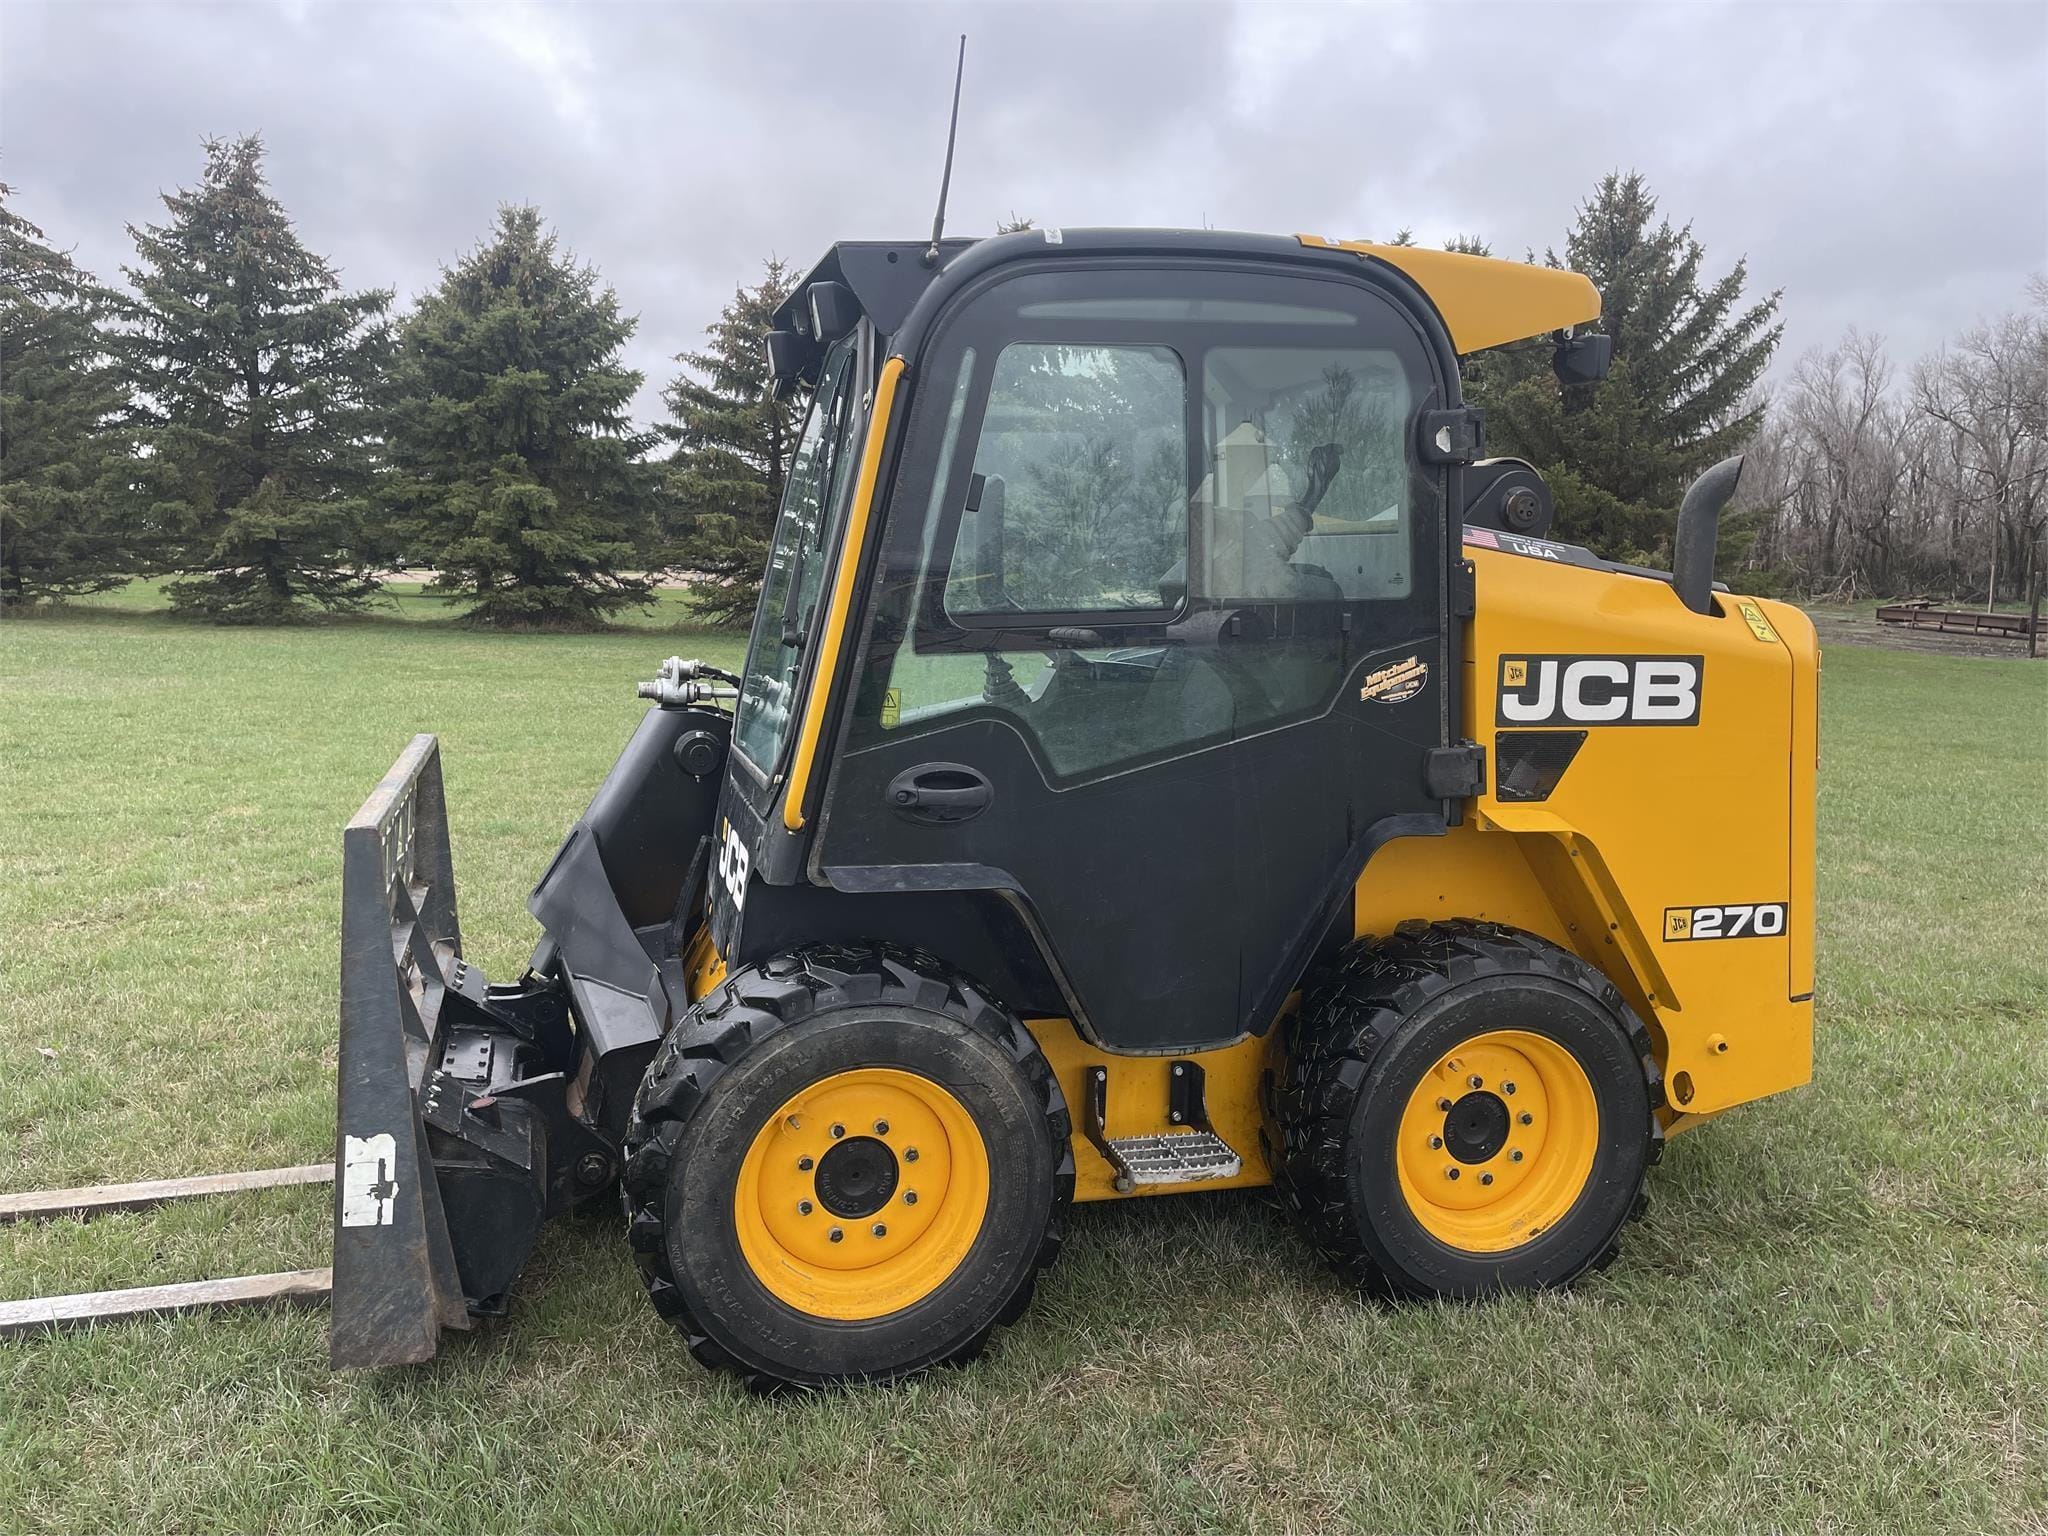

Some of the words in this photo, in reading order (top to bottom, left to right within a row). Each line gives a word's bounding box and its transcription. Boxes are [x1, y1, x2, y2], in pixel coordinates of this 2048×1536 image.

[1512, 542, 1559, 560] USA
[1360, 663, 1427, 700] Equipment
[1365, 655, 1417, 688] Mitchell
[1502, 660, 1697, 721] JCB
[719, 823, 749, 912] JCB
[1692, 904, 1783, 938] 270
